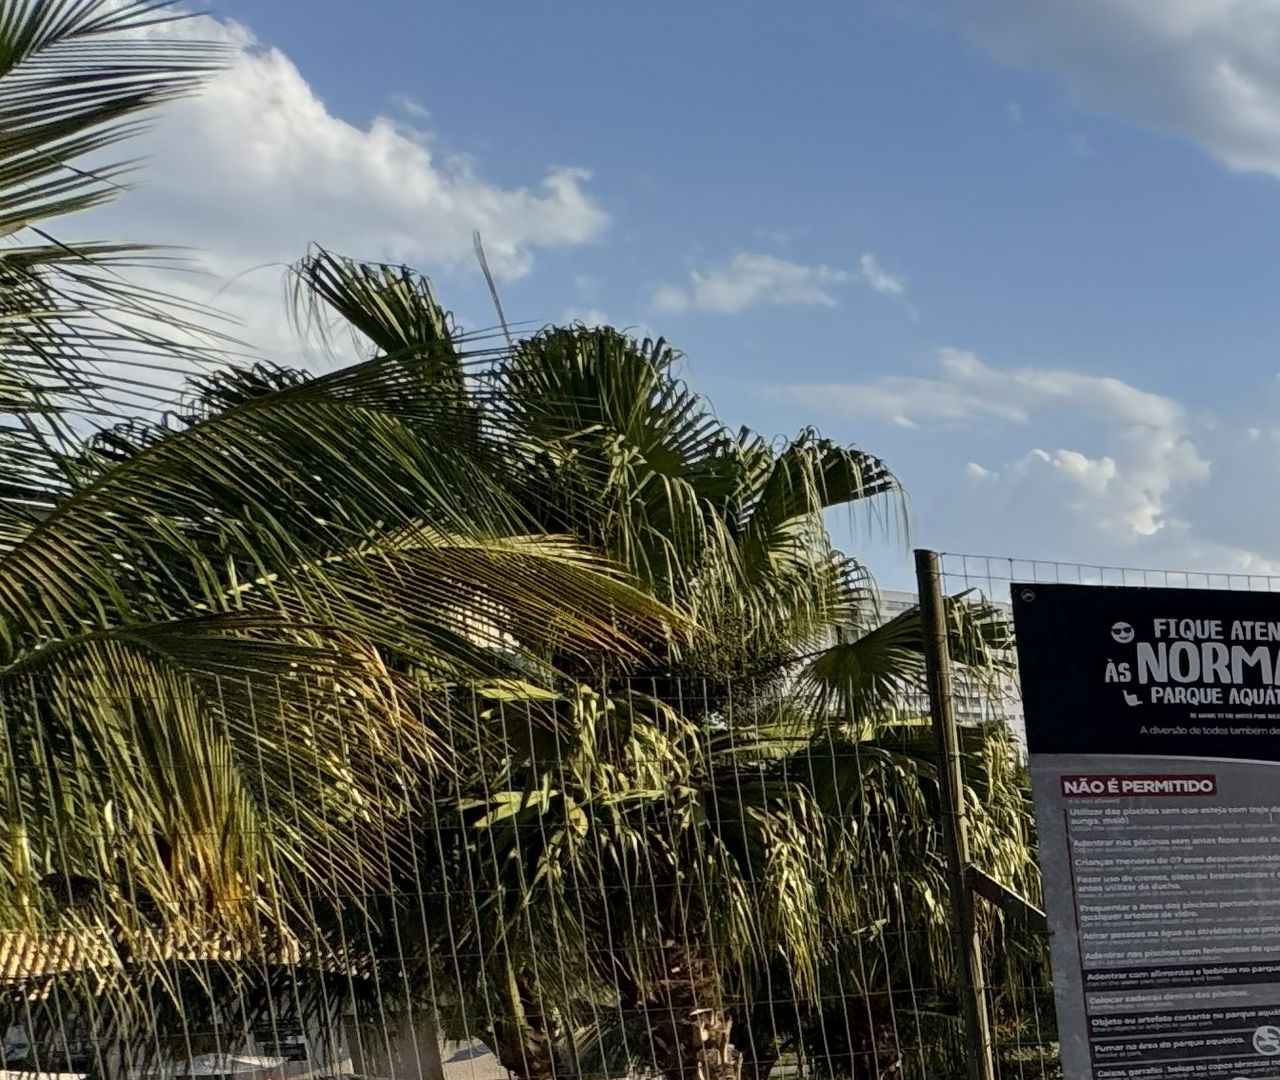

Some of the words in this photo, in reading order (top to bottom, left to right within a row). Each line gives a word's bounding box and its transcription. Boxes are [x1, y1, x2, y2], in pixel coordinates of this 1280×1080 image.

[1153, 618, 1224, 641] FIQUE
[1105, 658, 1132, 683] ÀS
[1150, 686, 1223, 706] PARQUE
[1140, 726, 1149, 735] A
[1149, 725, 1188, 735] diversão
[1189, 726, 1201, 735] de
[1230, 726, 1268, 735] também
[1064, 778, 1105, 794] NÃO
[1108, 777, 1119, 793] É
[1122, 779, 1213, 793] PERMITIDO
[1122, 807, 1158, 815] piscinas
[1181, 807, 1198, 815] que
[1133, 837, 1169, 846] piscinas
[1191, 836, 1216, 844] antes
[1074, 858, 1113, 867] Crianças
[1169, 856, 1181, 864] 07
[1077, 875, 1101, 883] Fazer
[1121, 874, 1133, 882] de
[1110, 931, 1145, 939] pessoas
[1243, 926, 1260, 934] que
[1144, 948, 1180, 958] piscinas
[1087, 971, 1126, 980] Adentrar
[1150, 968, 1193, 977] alimentos
[1202, 966, 1236, 974] bebidas
[1091, 1017, 1122, 1027] Objeto
[1174, 1012, 1211, 1021] cortante
[1225, 1011, 1256, 1019] parque
[1094, 1043, 1123, 1052] Fumar
[1173, 1040, 1204, 1049] parque
[1208, 1063, 1232, 1071] copos
